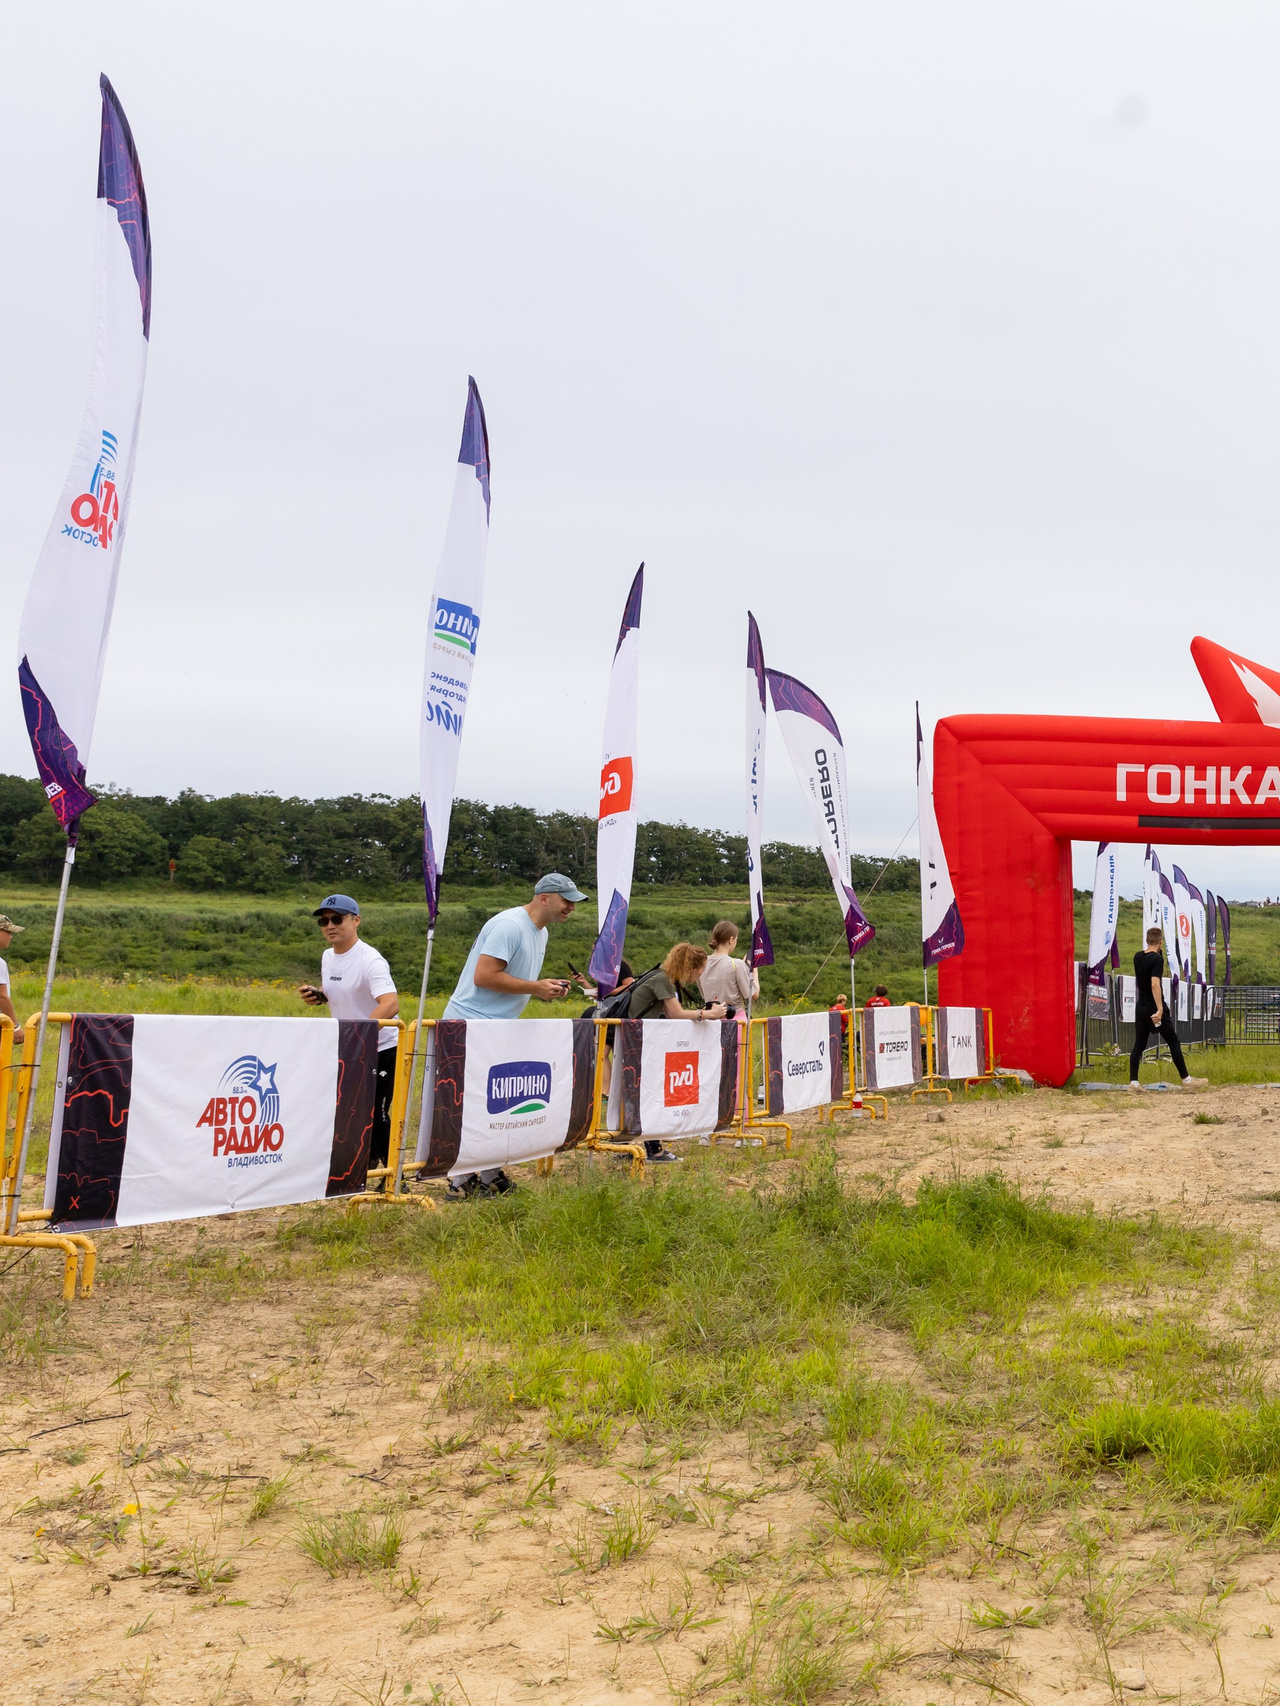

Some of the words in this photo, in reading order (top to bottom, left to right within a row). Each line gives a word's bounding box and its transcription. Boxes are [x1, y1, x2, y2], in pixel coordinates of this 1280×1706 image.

[885, 1041, 908, 1053] TORERO
[951, 1035, 972, 1048] TANK
[787, 1060, 823, 1079] Северсталь
[492, 1074, 547, 1100] КИПРИНО
[196, 1095, 257, 1128] АВТО
[213, 1123, 284, 1157] РАДИО
[228, 1153, 283, 1168] ВЛАДИВОСТОК
